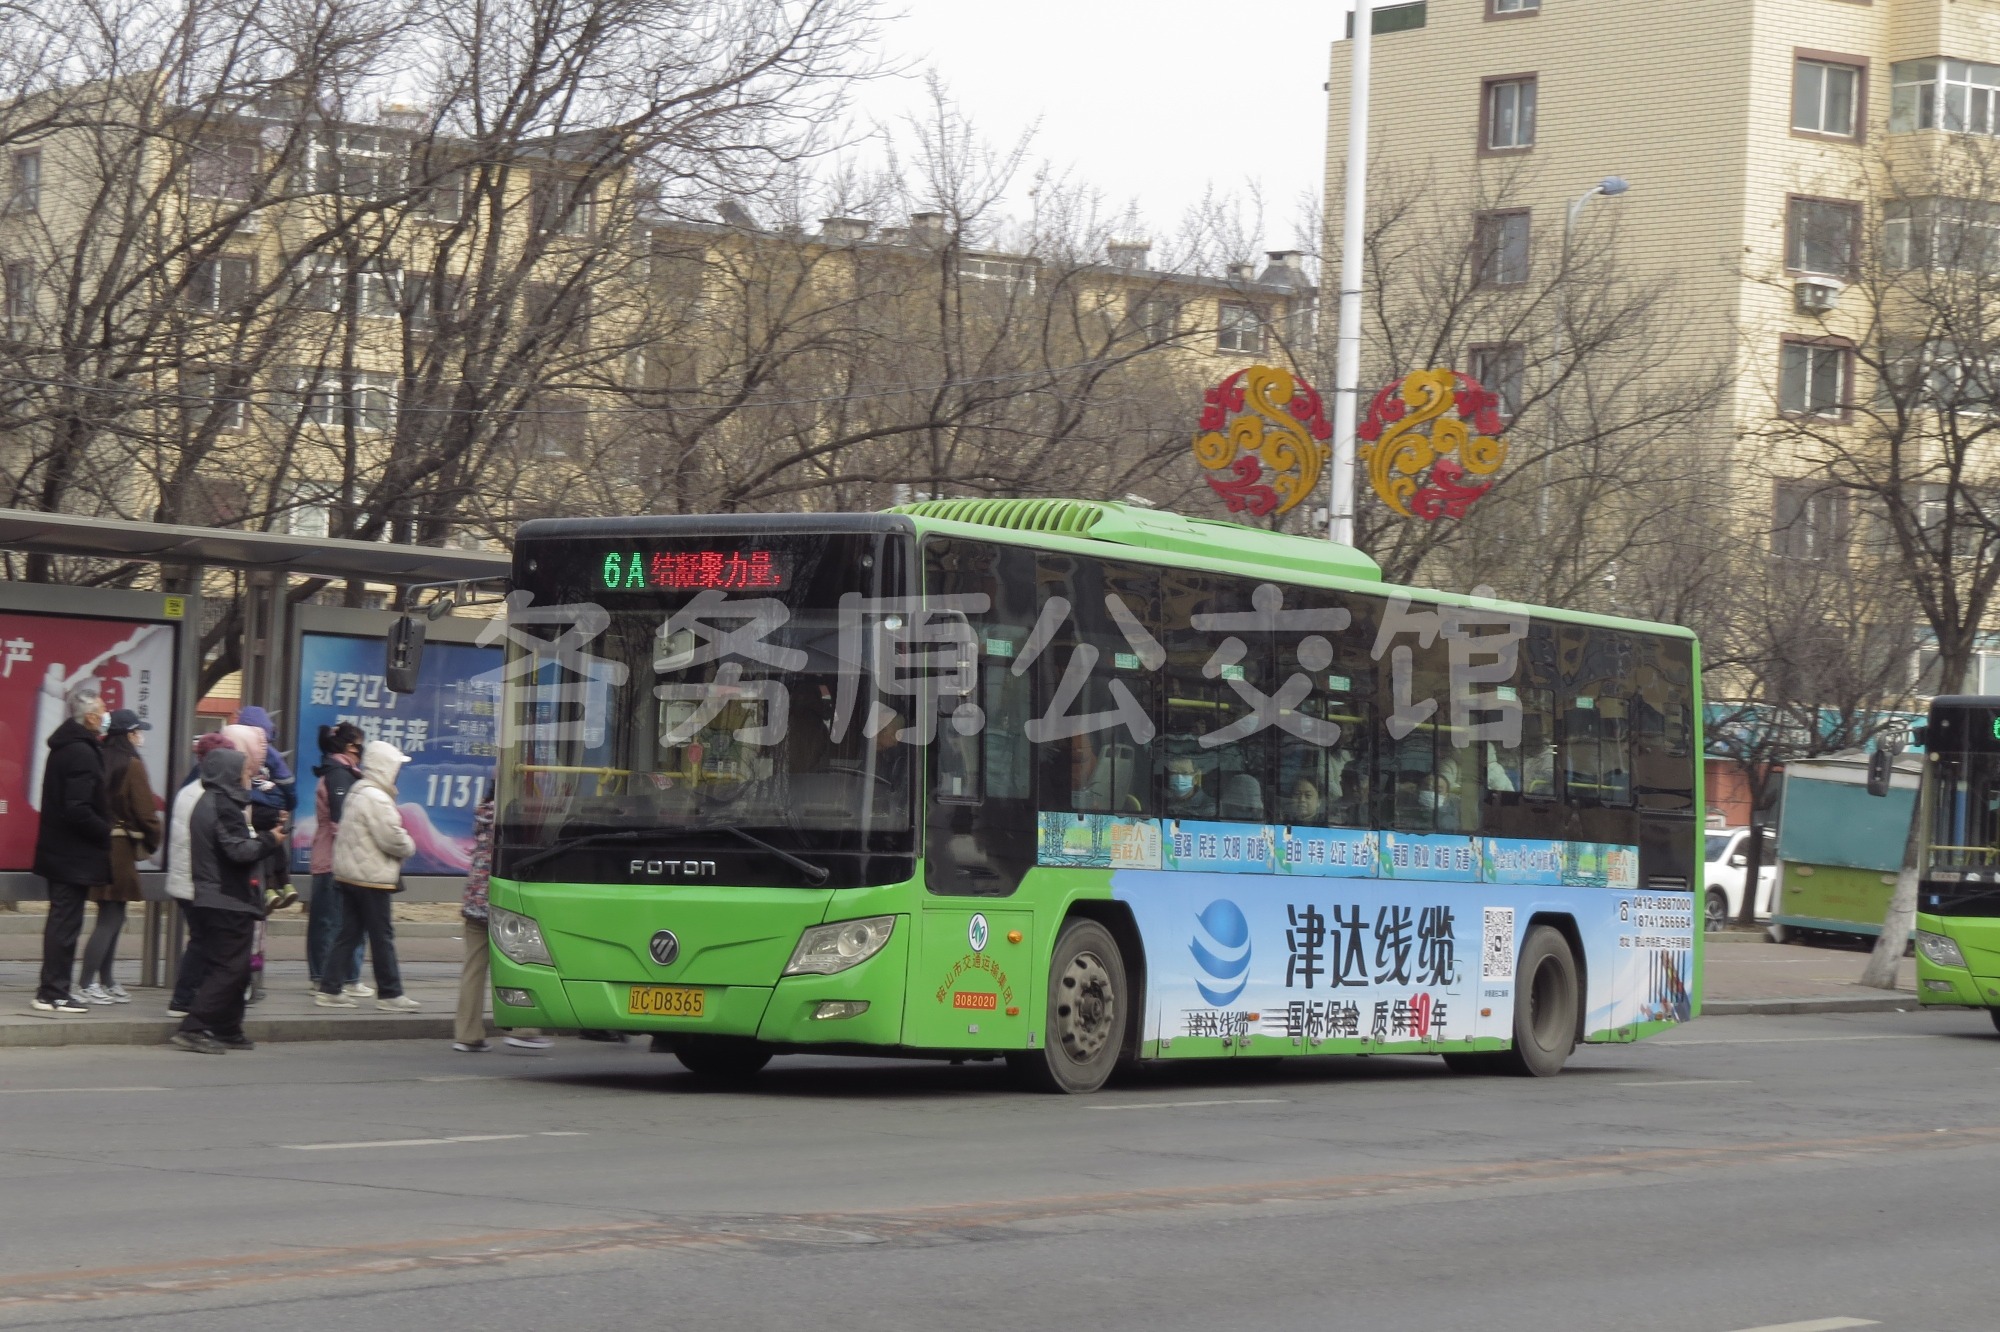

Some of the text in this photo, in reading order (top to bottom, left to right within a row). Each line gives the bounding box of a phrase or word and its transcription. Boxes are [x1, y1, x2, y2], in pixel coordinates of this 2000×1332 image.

[603, 551, 645, 588] 6A
[1173, 833, 1192, 858] 富强
[1199, 834, 1217, 859] 民主
[1222, 836, 1241, 860] 文明
[1246, 836, 1265, 861] 和谐
[1285, 839, 1302, 862] 自由
[1308, 840, 1325, 864] 平等
[1330, 841, 1347, 865] 公正
[630, 859, 716, 876] FOTON
[1286, 904, 1456, 987] 津达线缆
[954, 994, 995, 1008] 3082020
[1187, 1011, 1249, 1037] 津达线缆
